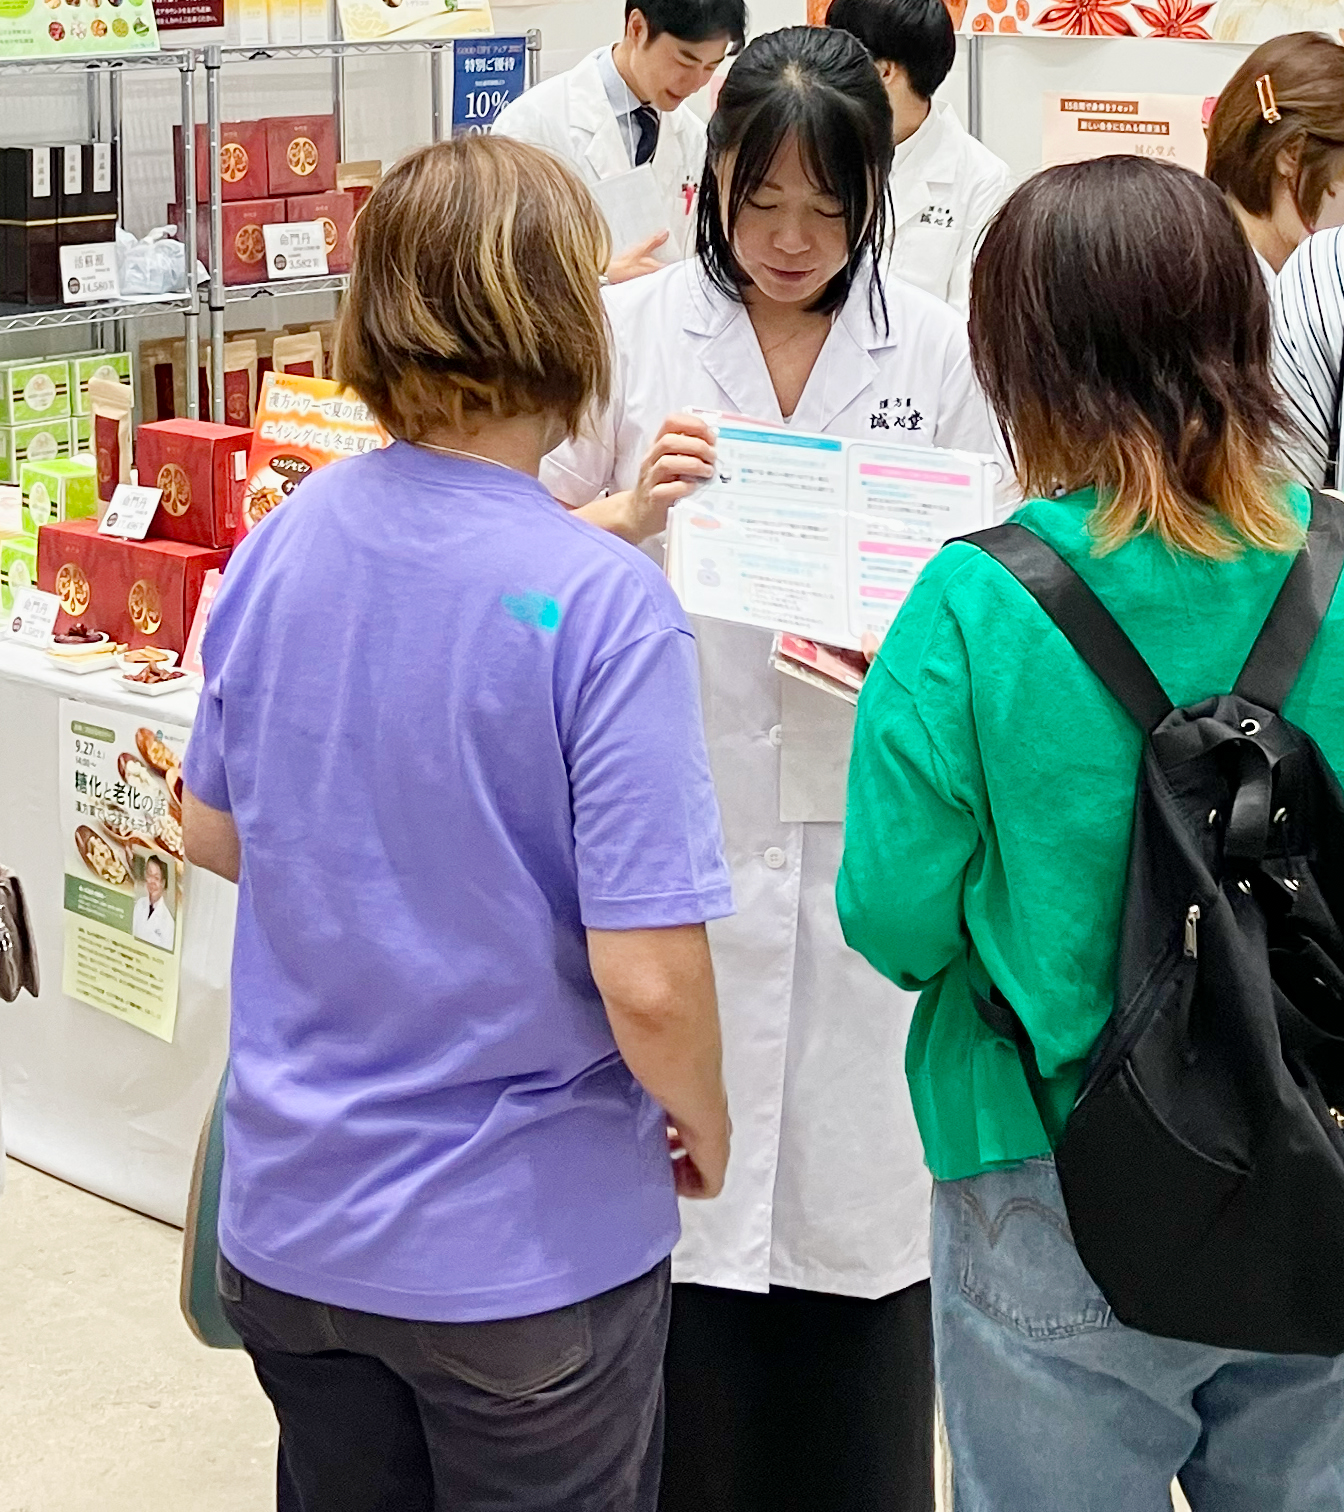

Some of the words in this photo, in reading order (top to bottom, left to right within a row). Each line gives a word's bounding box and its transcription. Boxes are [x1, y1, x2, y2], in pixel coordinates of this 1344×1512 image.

[464, 89, 510, 119] 10%
[869, 409, 924, 431] 誠心堂
[75, 769, 167, 817] 糖化と老化の話
